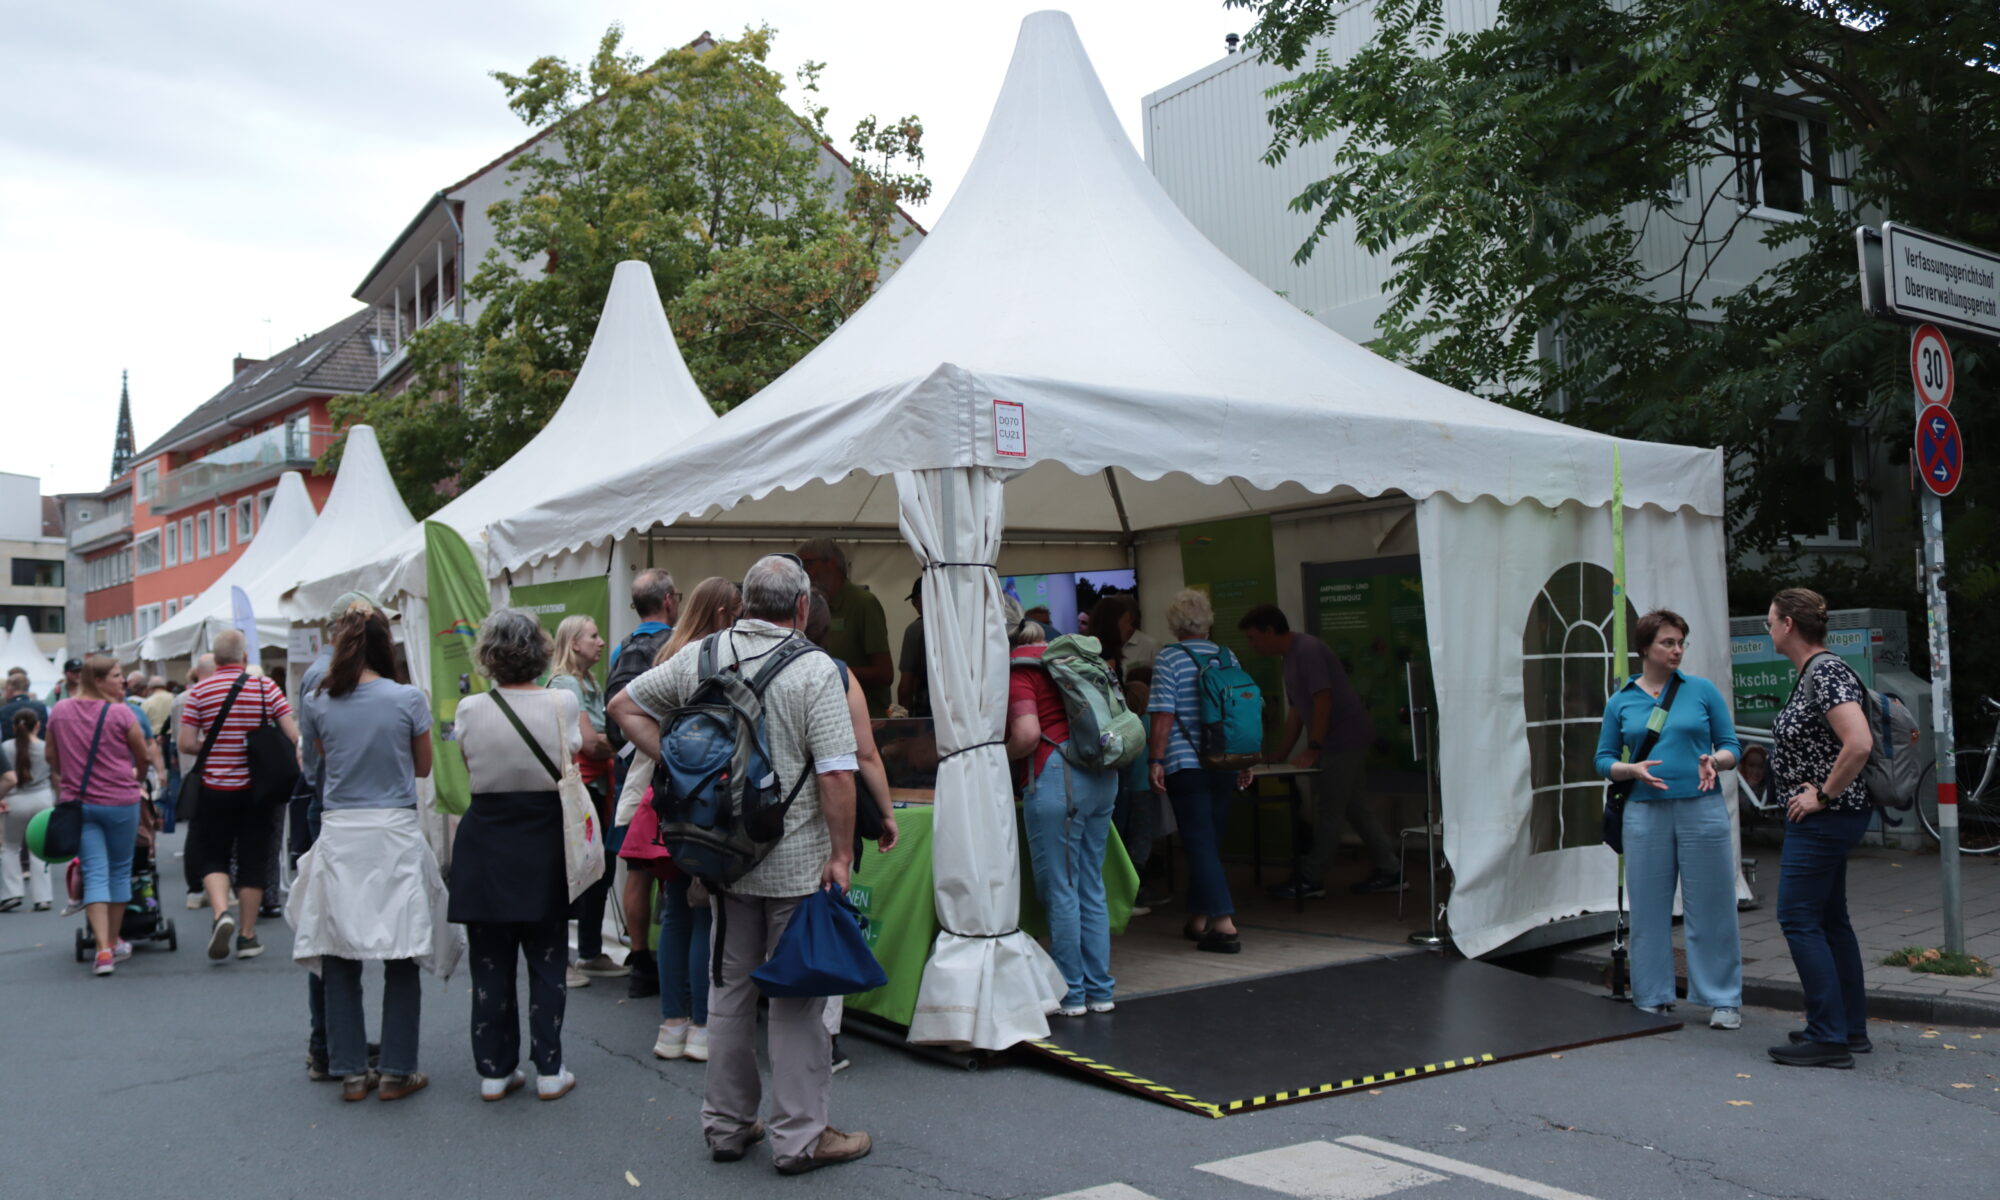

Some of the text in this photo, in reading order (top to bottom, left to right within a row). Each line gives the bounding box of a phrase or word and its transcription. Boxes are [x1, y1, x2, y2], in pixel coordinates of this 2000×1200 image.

[1904, 246, 1994, 289] Verfassungsgerichtshof
[1904, 275, 1997, 317] Oberverwaltungsgericht
[1923, 347, 1943, 390] 30
[999, 430, 1020, 439] CU21
[1731, 633, 1861, 653] ünster Wegen
